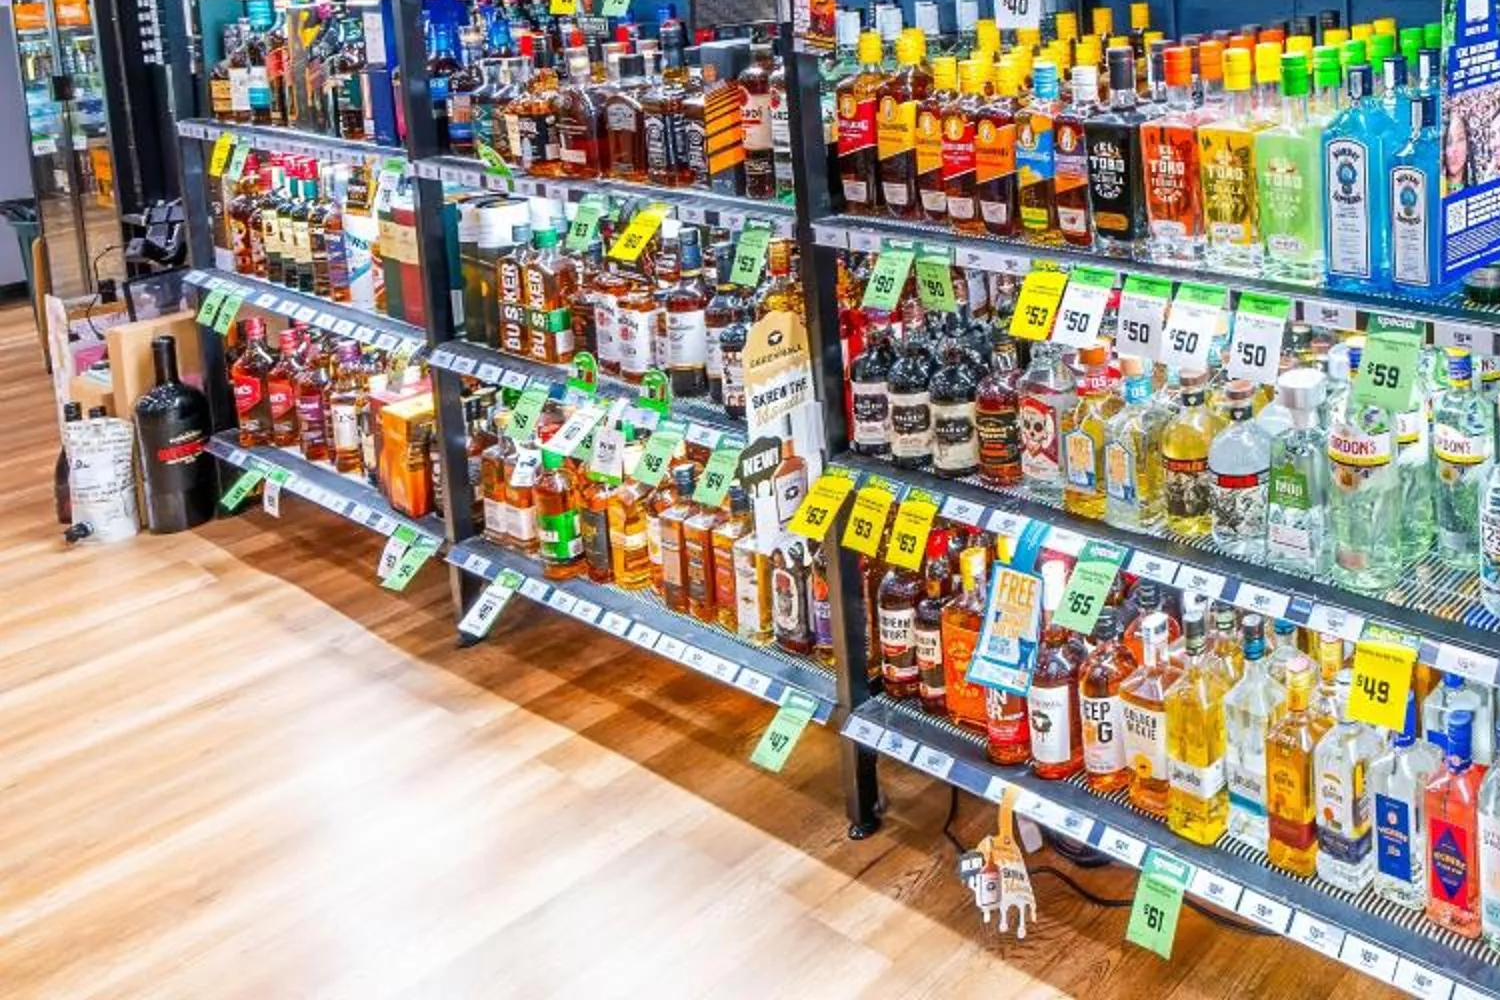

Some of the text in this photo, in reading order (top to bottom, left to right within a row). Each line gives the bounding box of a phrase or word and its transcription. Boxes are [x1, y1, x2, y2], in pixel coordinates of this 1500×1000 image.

[1150, 158, 1186, 177] TORO
[501, 261, 522, 352] BUSKER
[529, 268, 547, 359] BUSKER
[1025, 305, 1048, 326] $53
[1063, 309, 1090, 333] $50
[1122, 322, 1150, 345] $50
[1169, 328, 1199, 353] $50
[1237, 340, 1267, 367] $50
[1366, 362, 1401, 389] $59
[741, 448, 781, 478] NEW!
[998, 569, 1037, 607] FREE
[1069, 589, 1095, 616] $65
[1355, 674, 1391, 704] $49
[1143, 902, 1164, 932] $61
